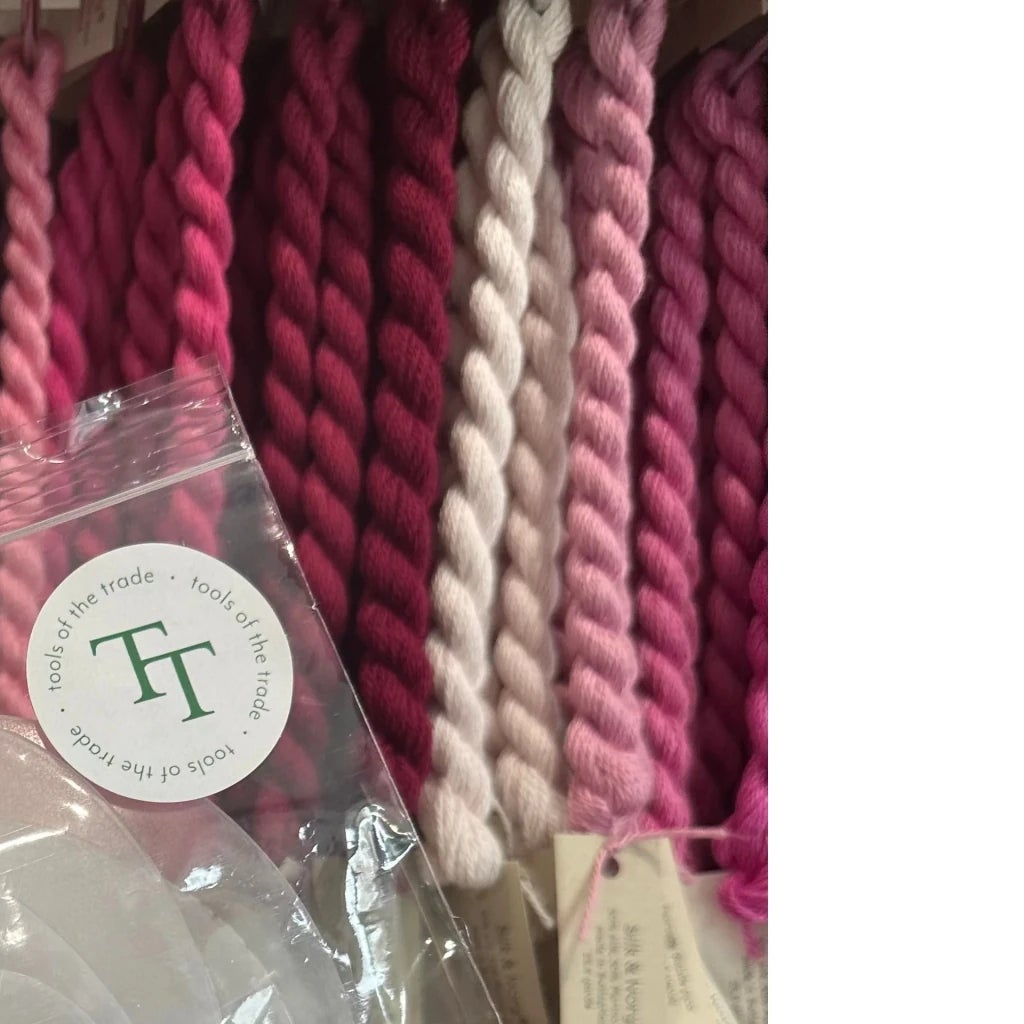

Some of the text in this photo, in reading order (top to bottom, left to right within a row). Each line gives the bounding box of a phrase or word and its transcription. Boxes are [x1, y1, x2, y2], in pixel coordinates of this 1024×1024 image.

[44, 566, 154, 692] tools of the trade
[190, 576, 271, 721] tools of the trade
[70, 725, 235, 783] tools of the trade
